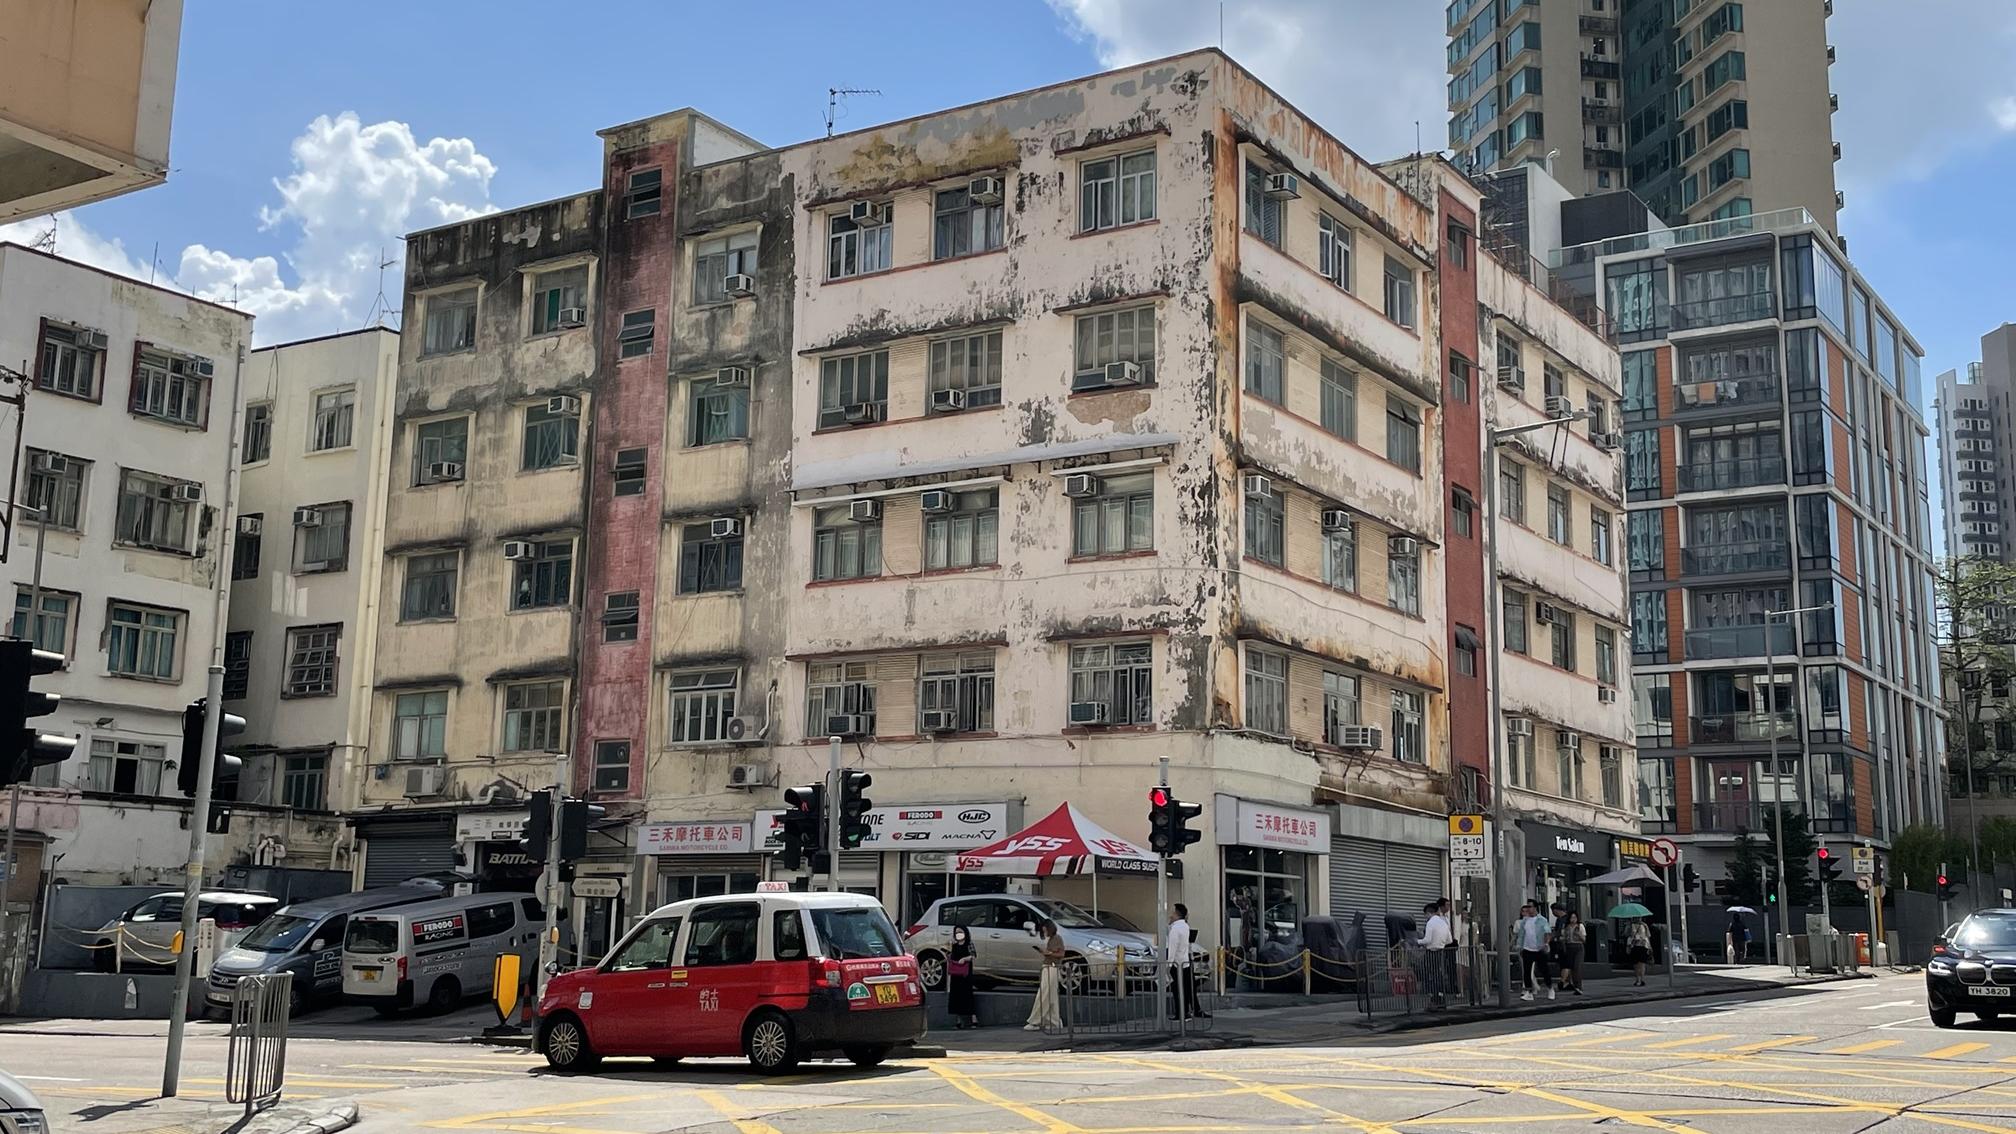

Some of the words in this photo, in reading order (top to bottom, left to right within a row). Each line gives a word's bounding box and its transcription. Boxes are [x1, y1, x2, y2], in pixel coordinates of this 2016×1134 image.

[962, 812, 986, 820] HJC
[1255, 813, 1317, 837] 三禾摩托車公司
[648, 826, 743, 842] 三禾摩托車公司
[993, 836, 1072, 855] YSS
[955, 857, 984, 871] YSS
[1101, 859, 1122, 869] WORLD
[1122, 861, 1141, 870] CLASS
[1141, 863, 1160, 872] SUSP
[423, 920, 453, 932] FERODO
[424, 930, 454, 940] RACING
[700, 989, 719, 1000] 的士
[700, 1000, 719, 1011] TAXI
